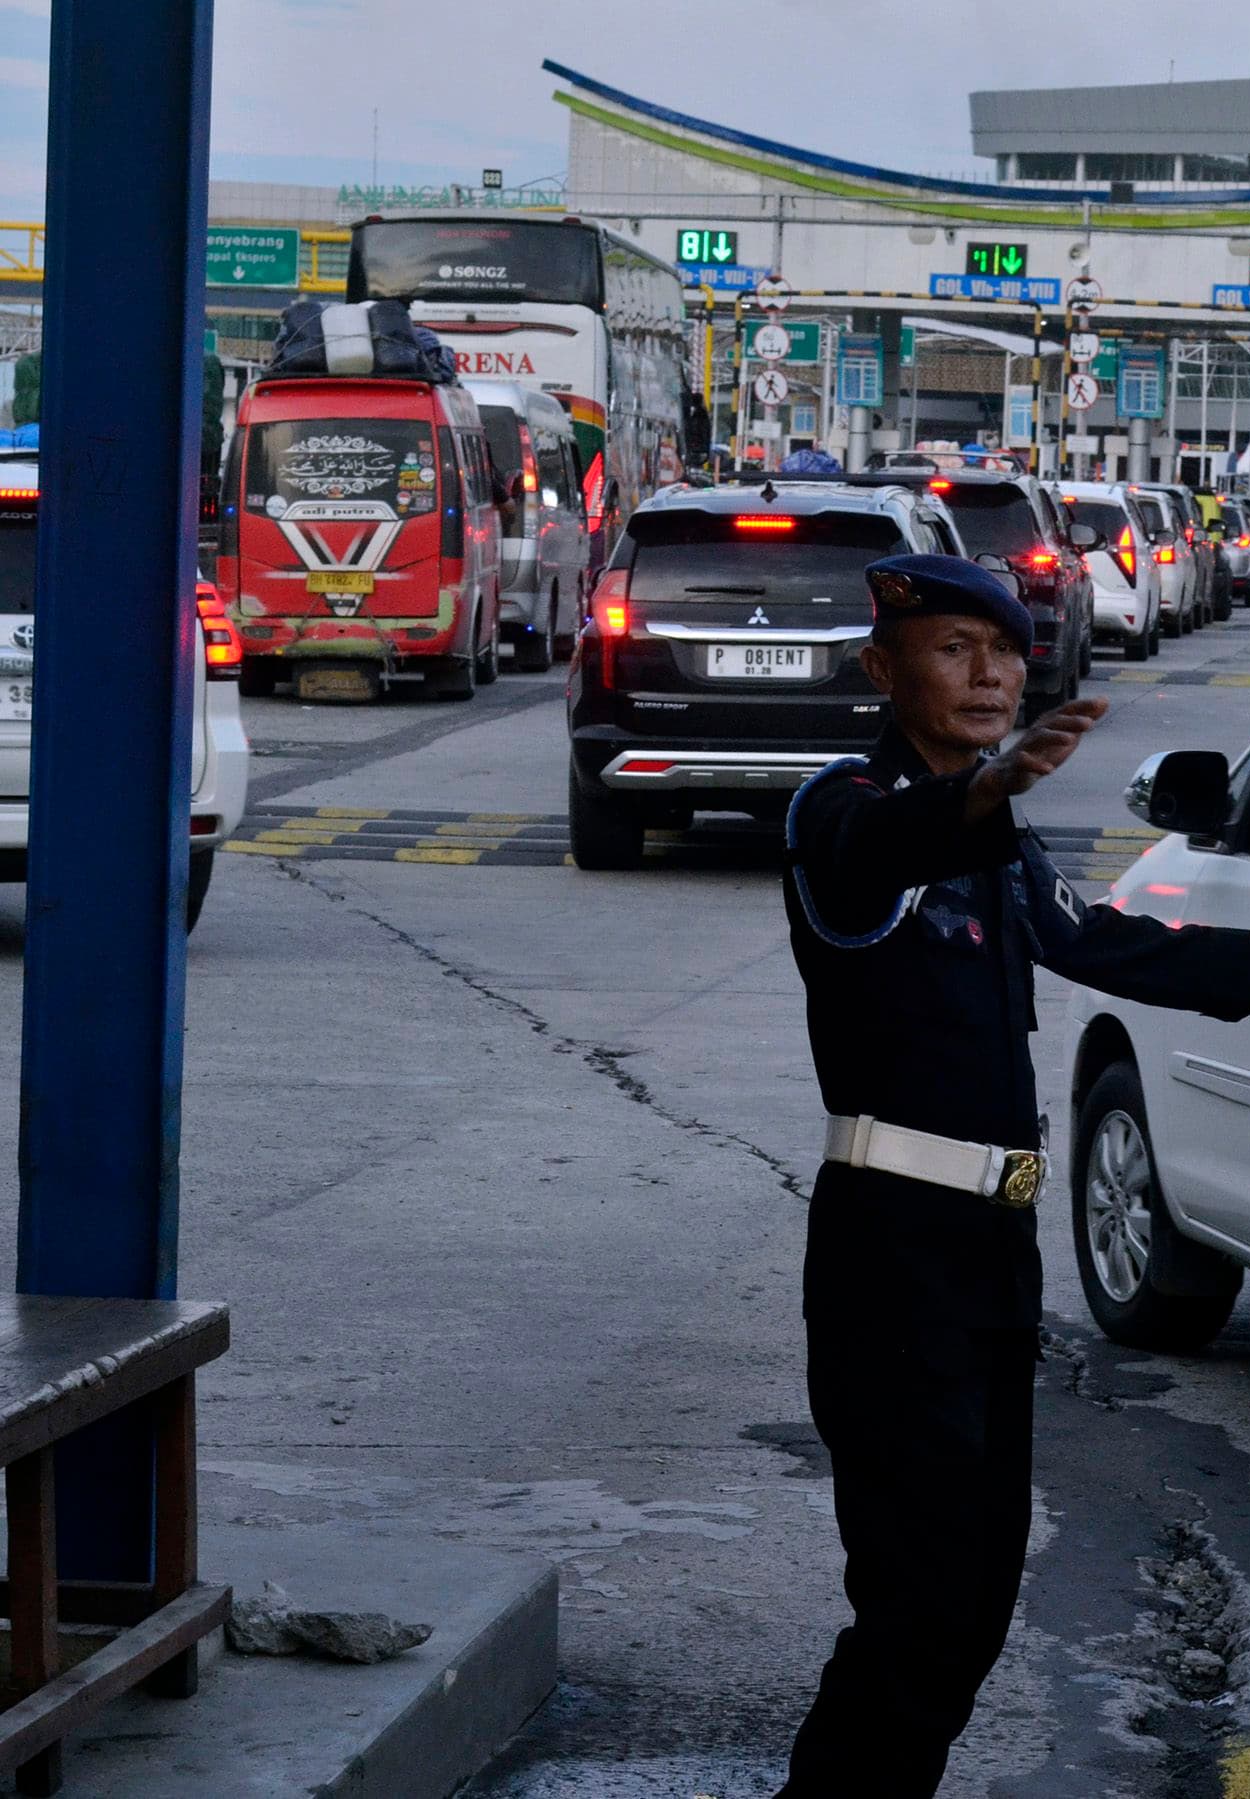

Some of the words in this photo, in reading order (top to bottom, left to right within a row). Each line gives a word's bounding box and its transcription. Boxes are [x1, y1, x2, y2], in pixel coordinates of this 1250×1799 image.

[207, 235, 284, 250] enyebrang
[682, 231, 699, 260] 8
[207, 252, 231, 262] apal
[453, 266, 507, 278] SONGZ
[936, 279, 964, 296] GOL
[454, 352, 536, 374] RENA
[332, 508, 375, 516] putro
[716, 648, 724, 664] P
[745, 649, 806, 665] 081ENT
[853, 705, 880, 713] DAKAR
